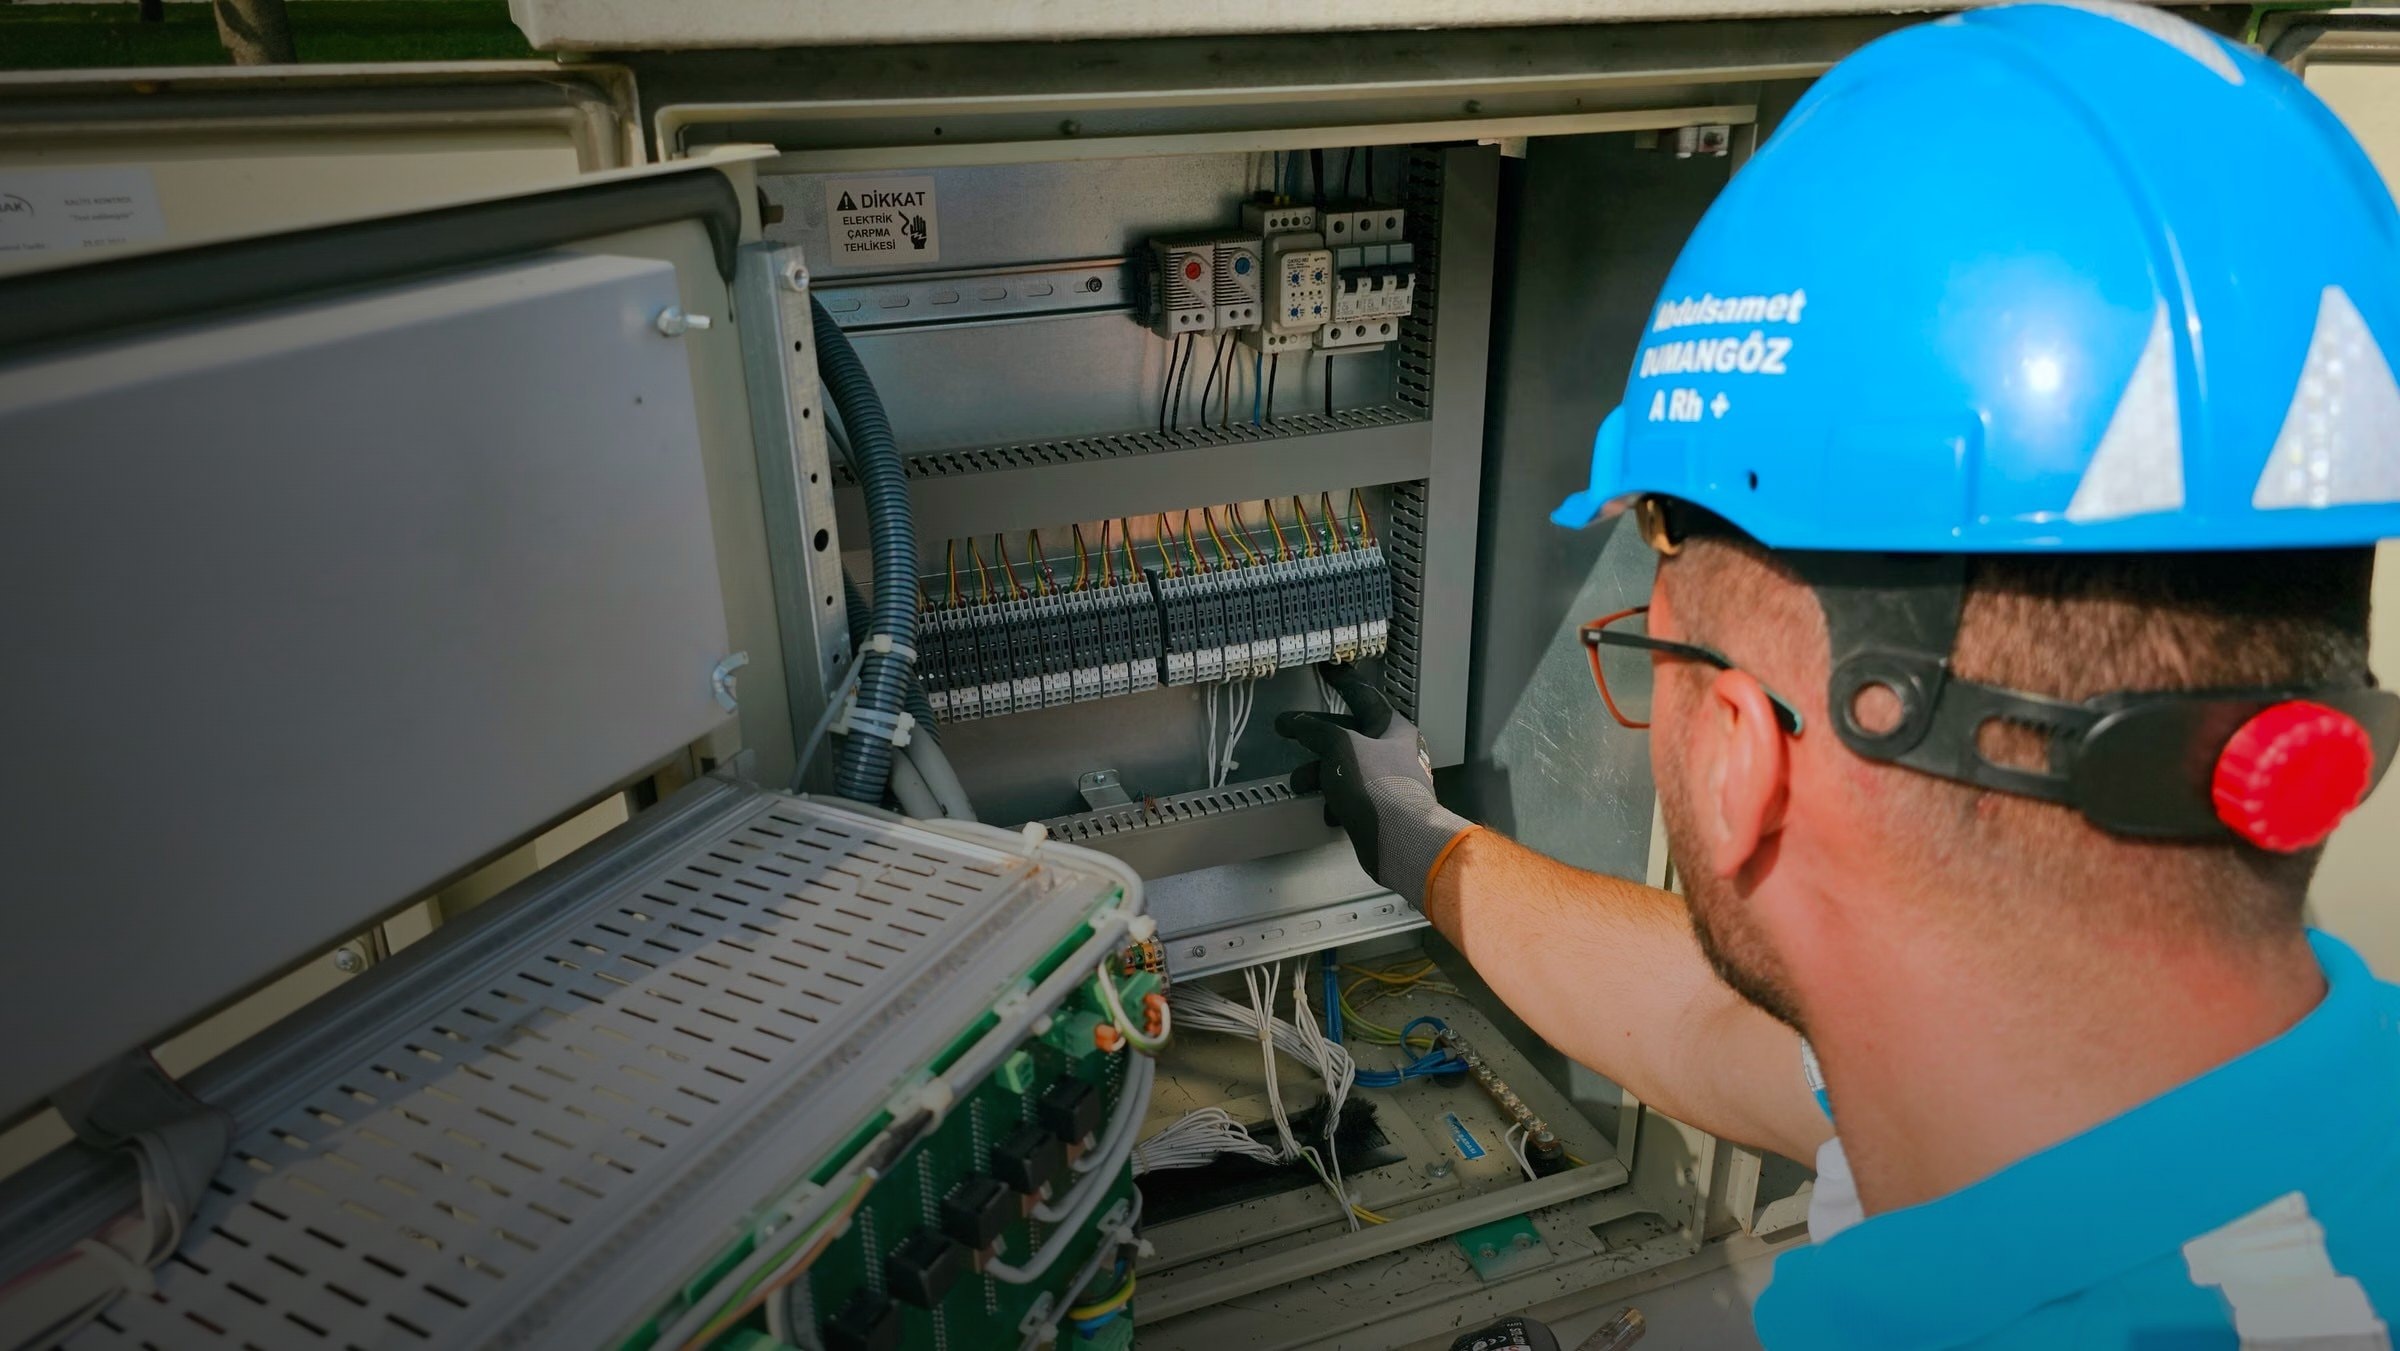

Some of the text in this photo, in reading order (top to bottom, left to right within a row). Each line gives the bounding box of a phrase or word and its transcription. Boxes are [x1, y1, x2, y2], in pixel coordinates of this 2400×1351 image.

[861, 189, 926, 209] DİKKAT
[842, 212, 893, 225] ELEKTRİK
[847, 228, 891, 240] ÇARPMA
[844, 239, 896, 252] TEHLİKESİ
[1647, 388, 1667, 422] A
[1667, 387, 1704, 422] Rh
